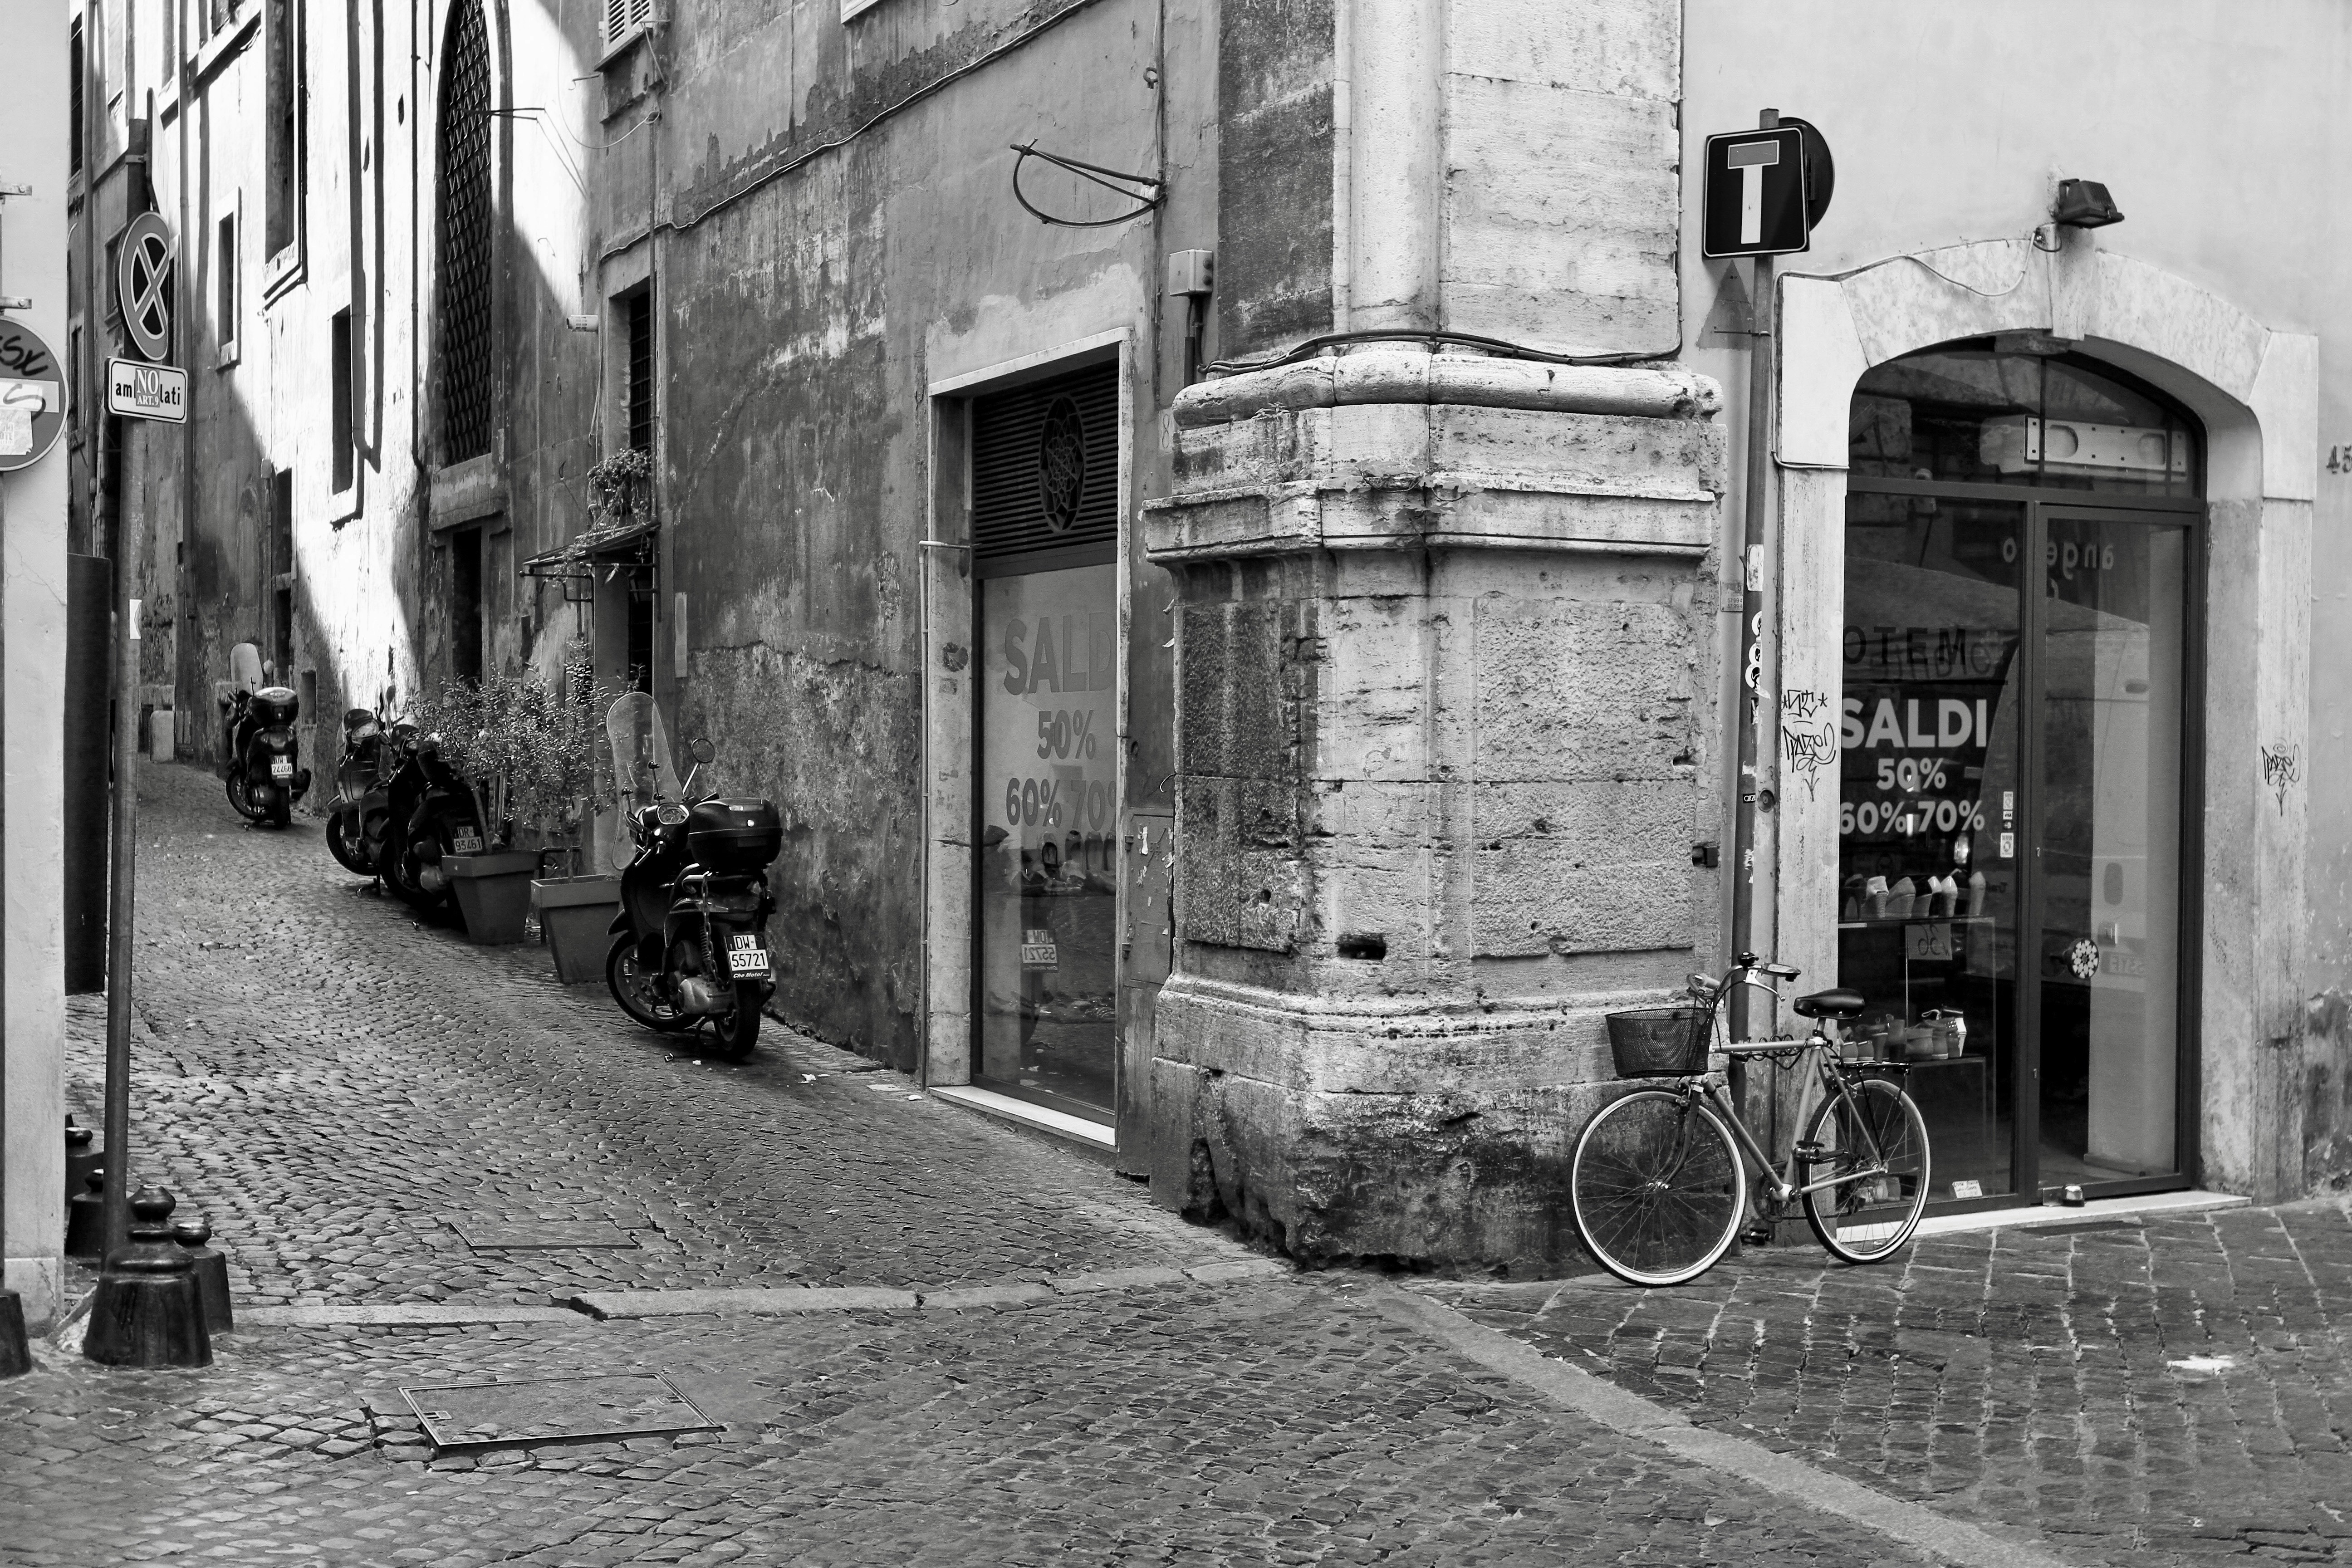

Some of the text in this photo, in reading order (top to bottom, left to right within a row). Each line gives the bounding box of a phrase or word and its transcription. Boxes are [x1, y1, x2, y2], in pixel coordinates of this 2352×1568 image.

[137, 370, 158, 394] NO
[160, 384, 180, 405] lati
[137, 395, 159, 406] ART.9
[1004, 612, 1117, 696] SALD
[1843, 625, 1966, 665] OTEM
[1037, 710, 1096, 760] 50%
[1841, 697, 1987, 749] SALDI
[1877, 758, 1946, 790] 50%
[1006, 778, 1062, 828] 60%
[1840, 800, 1985, 834] 60% 70%
[456, 838, 480, 851] 93461
[735, 936, 750, 949] DW
[732, 953, 765, 967] 55721
